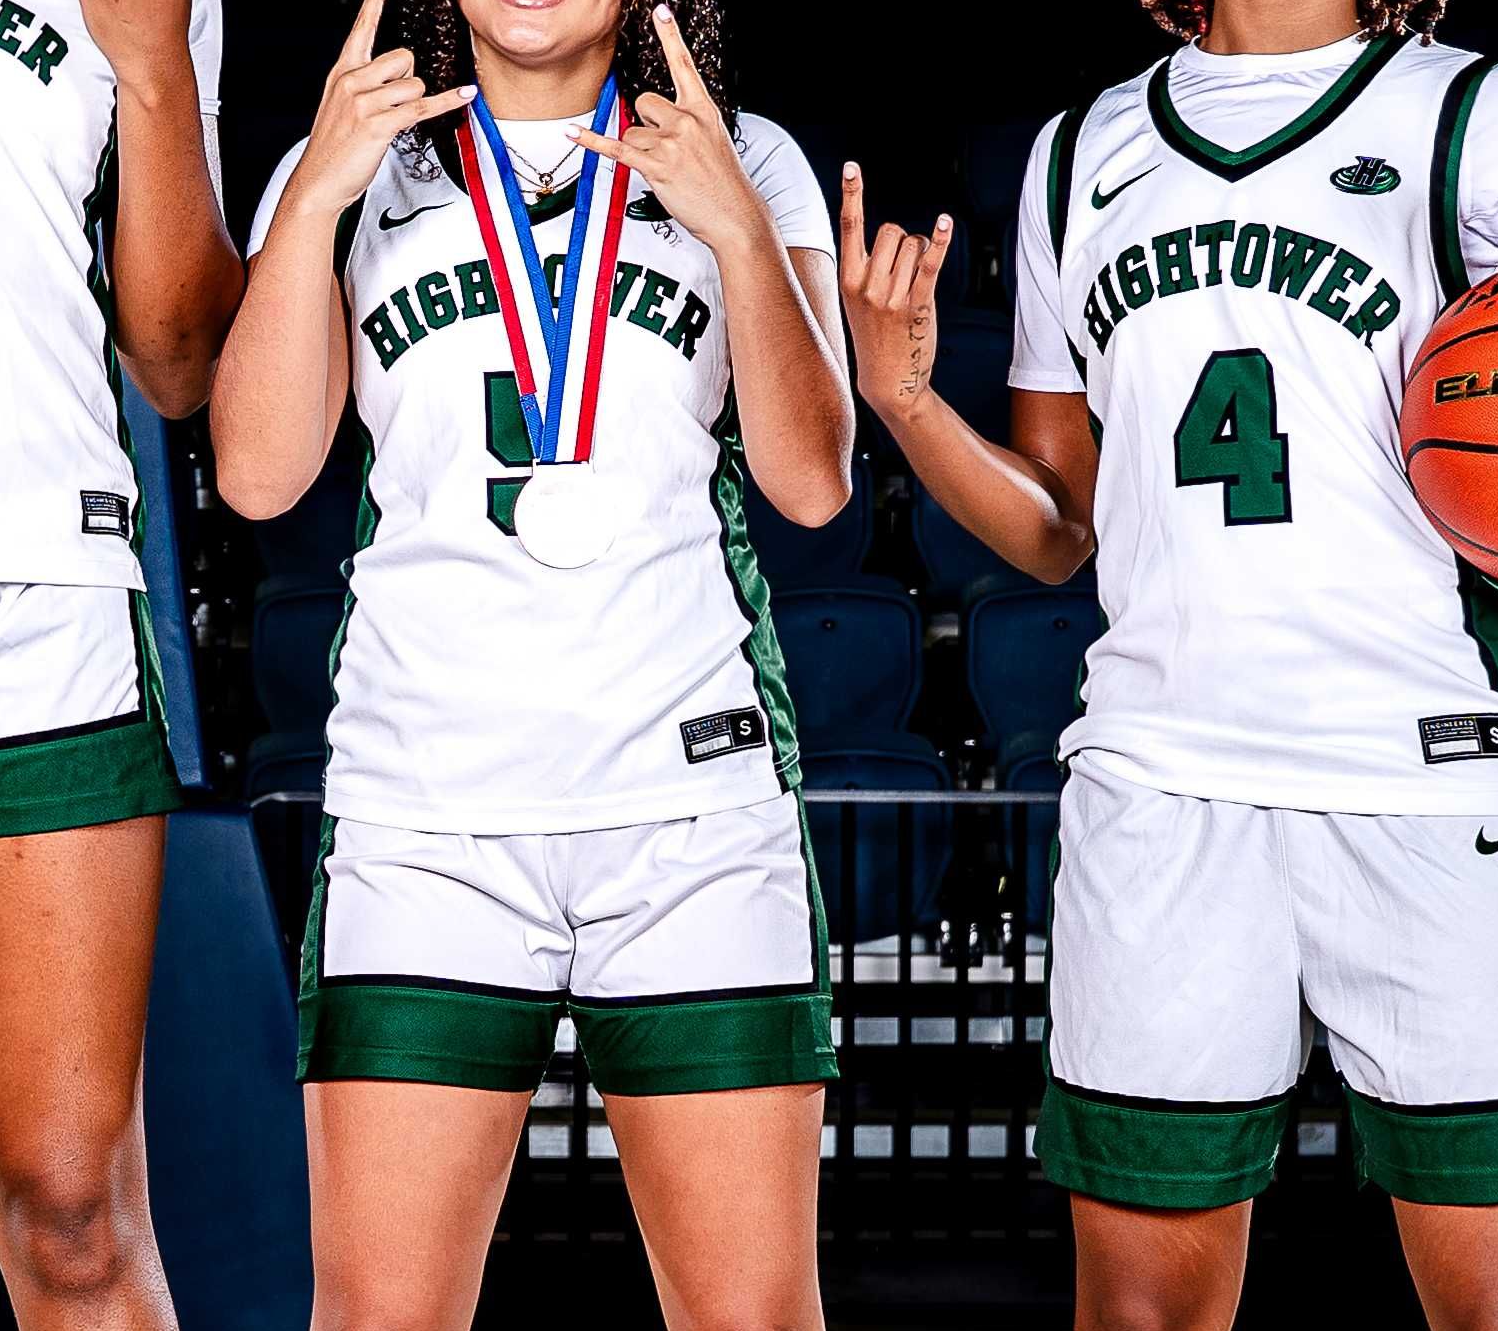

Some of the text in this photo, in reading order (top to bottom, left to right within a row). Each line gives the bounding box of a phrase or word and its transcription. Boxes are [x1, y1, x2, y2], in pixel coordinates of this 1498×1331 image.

[360, 253, 711, 372] HIGHER
[1084, 220, 1401, 356] HIGHTOWER
[1173, 347, 1293, 527] 4
[739, 720, 752, 736] S
